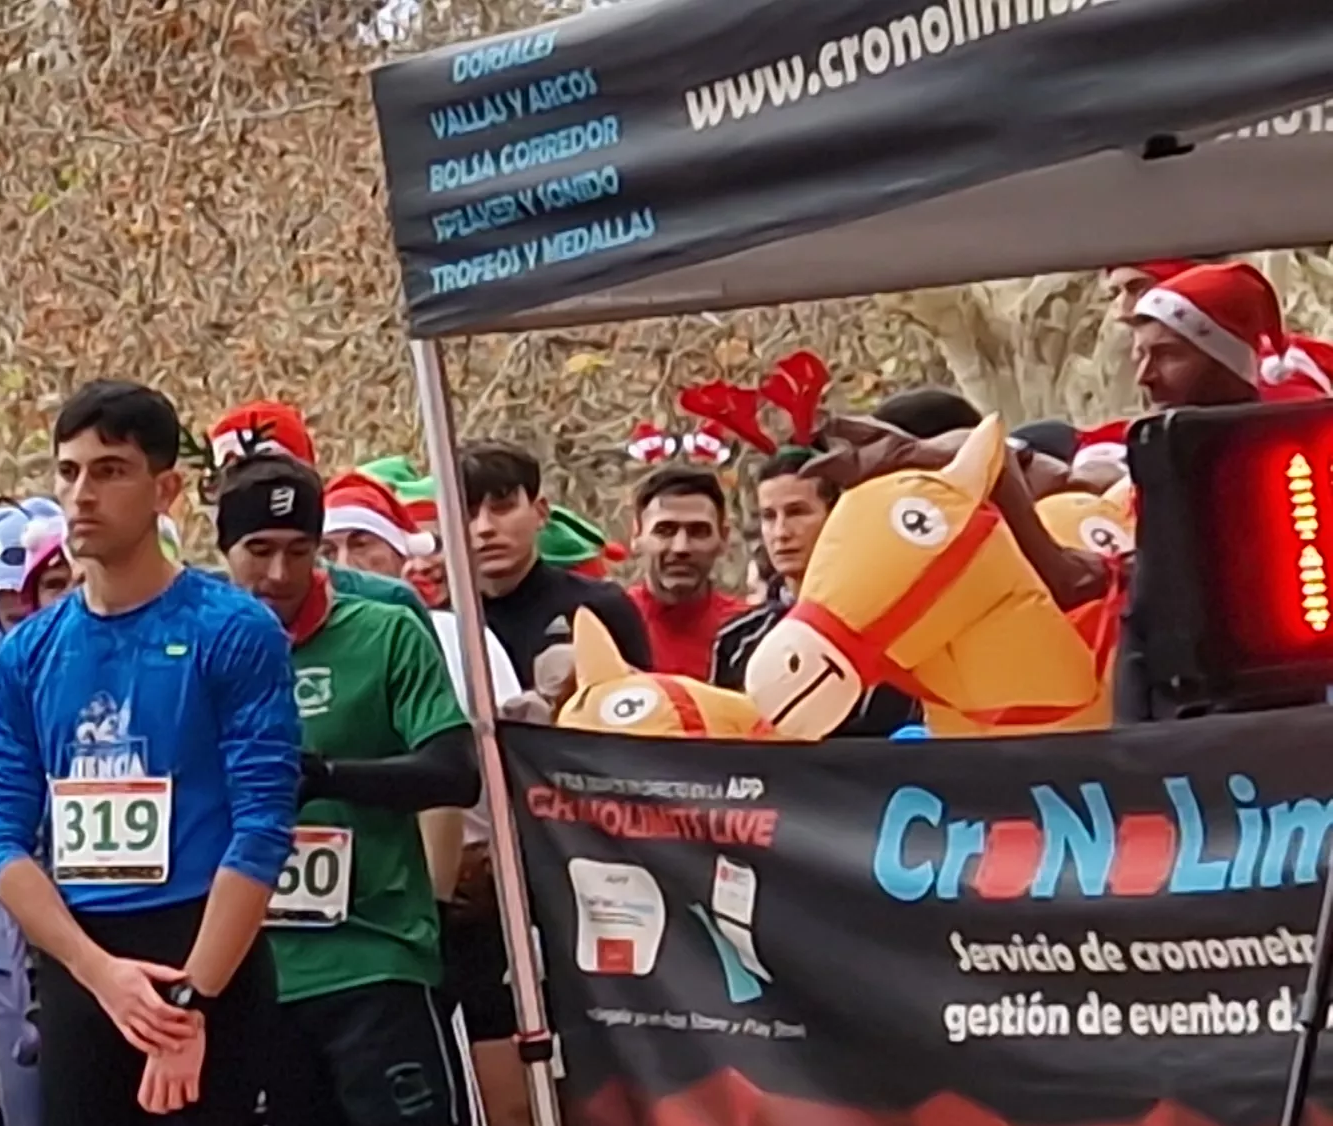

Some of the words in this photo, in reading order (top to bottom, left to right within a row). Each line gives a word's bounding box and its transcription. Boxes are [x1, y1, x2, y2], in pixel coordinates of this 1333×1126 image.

[685, 0, 1115, 130] www.cronolim
[430, 97, 508, 139] VALLAS
[508, 88, 524, 117] Y
[529, 67, 598, 113] ARCOS
[430, 150, 496, 192] BOLSA
[500, 115, 619, 175] CORREDOR
[518, 189, 536, 216] Y
[536, 165, 619, 211] SONIDO
[430, 249, 521, 294] TROFEOS
[524, 240, 537, 270] Y
[542, 207, 655, 264] MEDALLAS
[725, 776, 765, 800] APP
[64, 799, 159, 851] 319
[709, 808, 779, 848] LIVE
[276, 848, 340, 897] 60
[950, 930, 1076, 973] Servicio
[1080, 931, 1127, 973] de
[1132, 926, 1317, 973] cronometr
[944, 991, 1070, 1042] gestión
[1077, 991, 1122, 1035] de
[1130, 993, 1260, 1035] eventos
